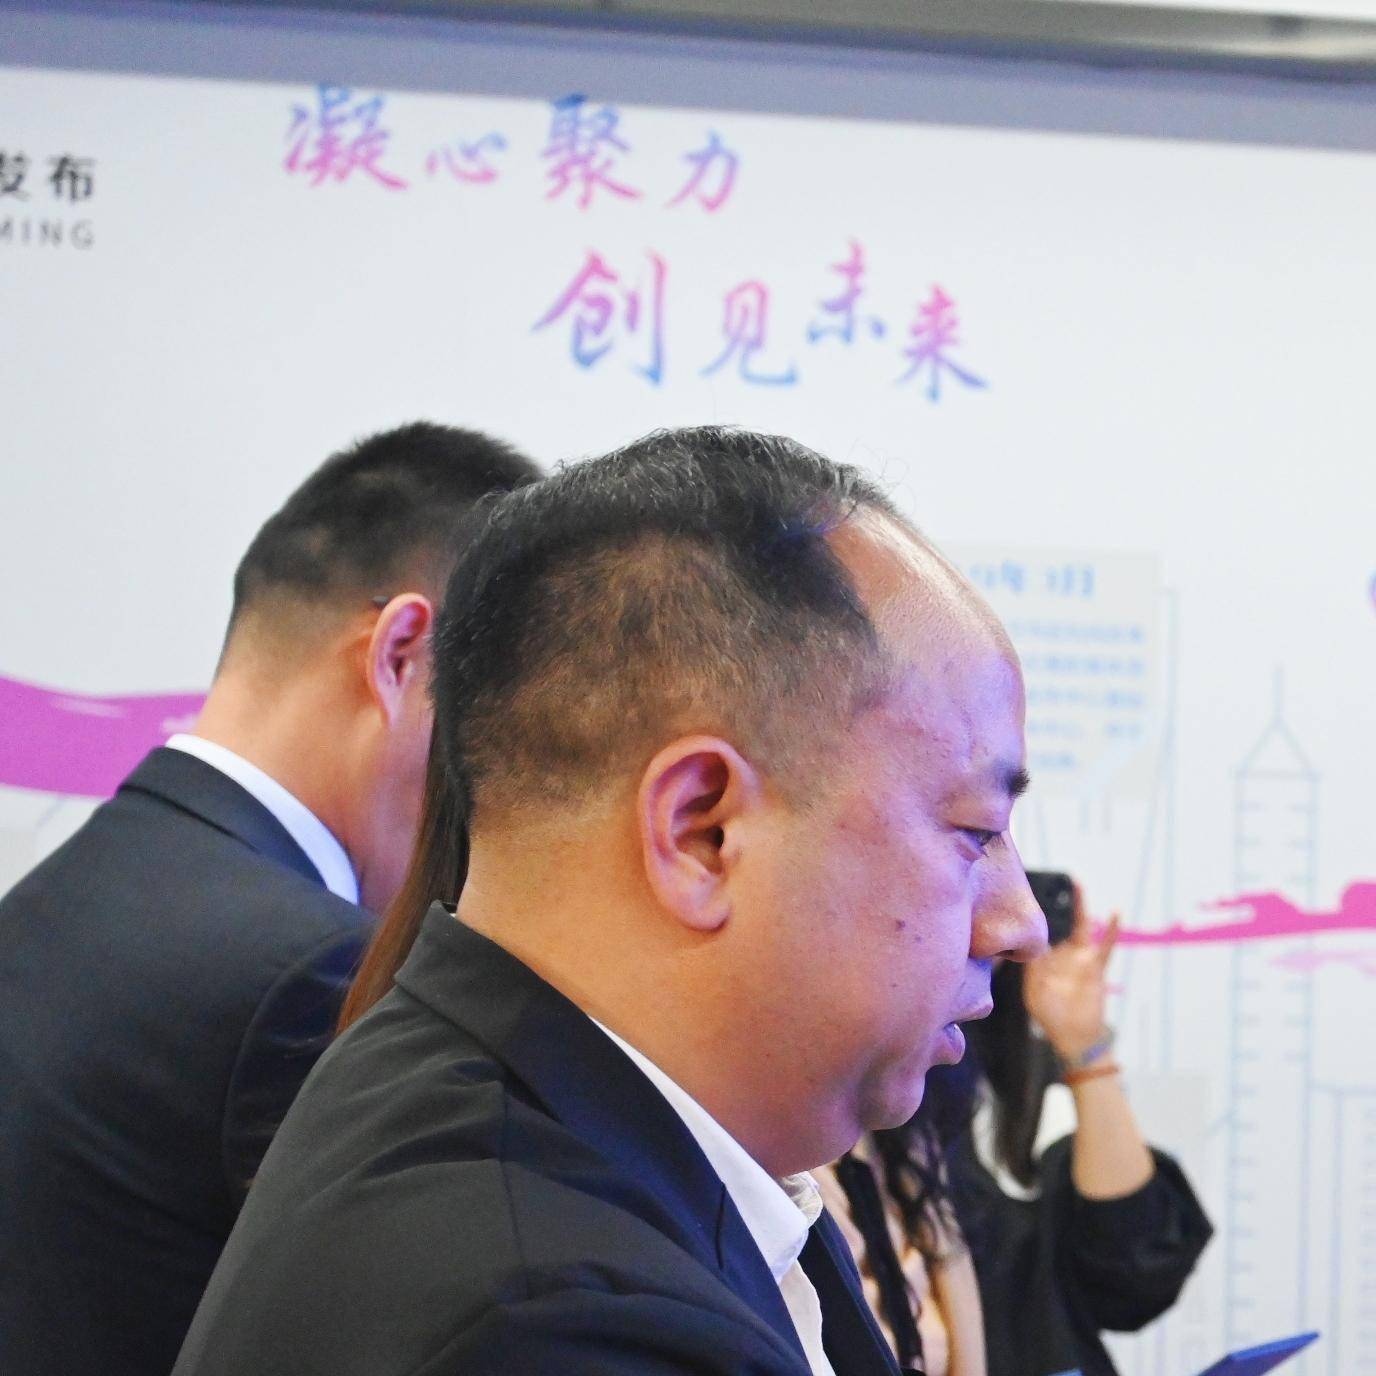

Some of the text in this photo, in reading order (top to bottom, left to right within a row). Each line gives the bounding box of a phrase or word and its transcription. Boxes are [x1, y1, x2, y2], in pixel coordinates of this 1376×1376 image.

[284, 82, 742, 213] 凝心聚力
[530, 236, 991, 403] 创见未来
